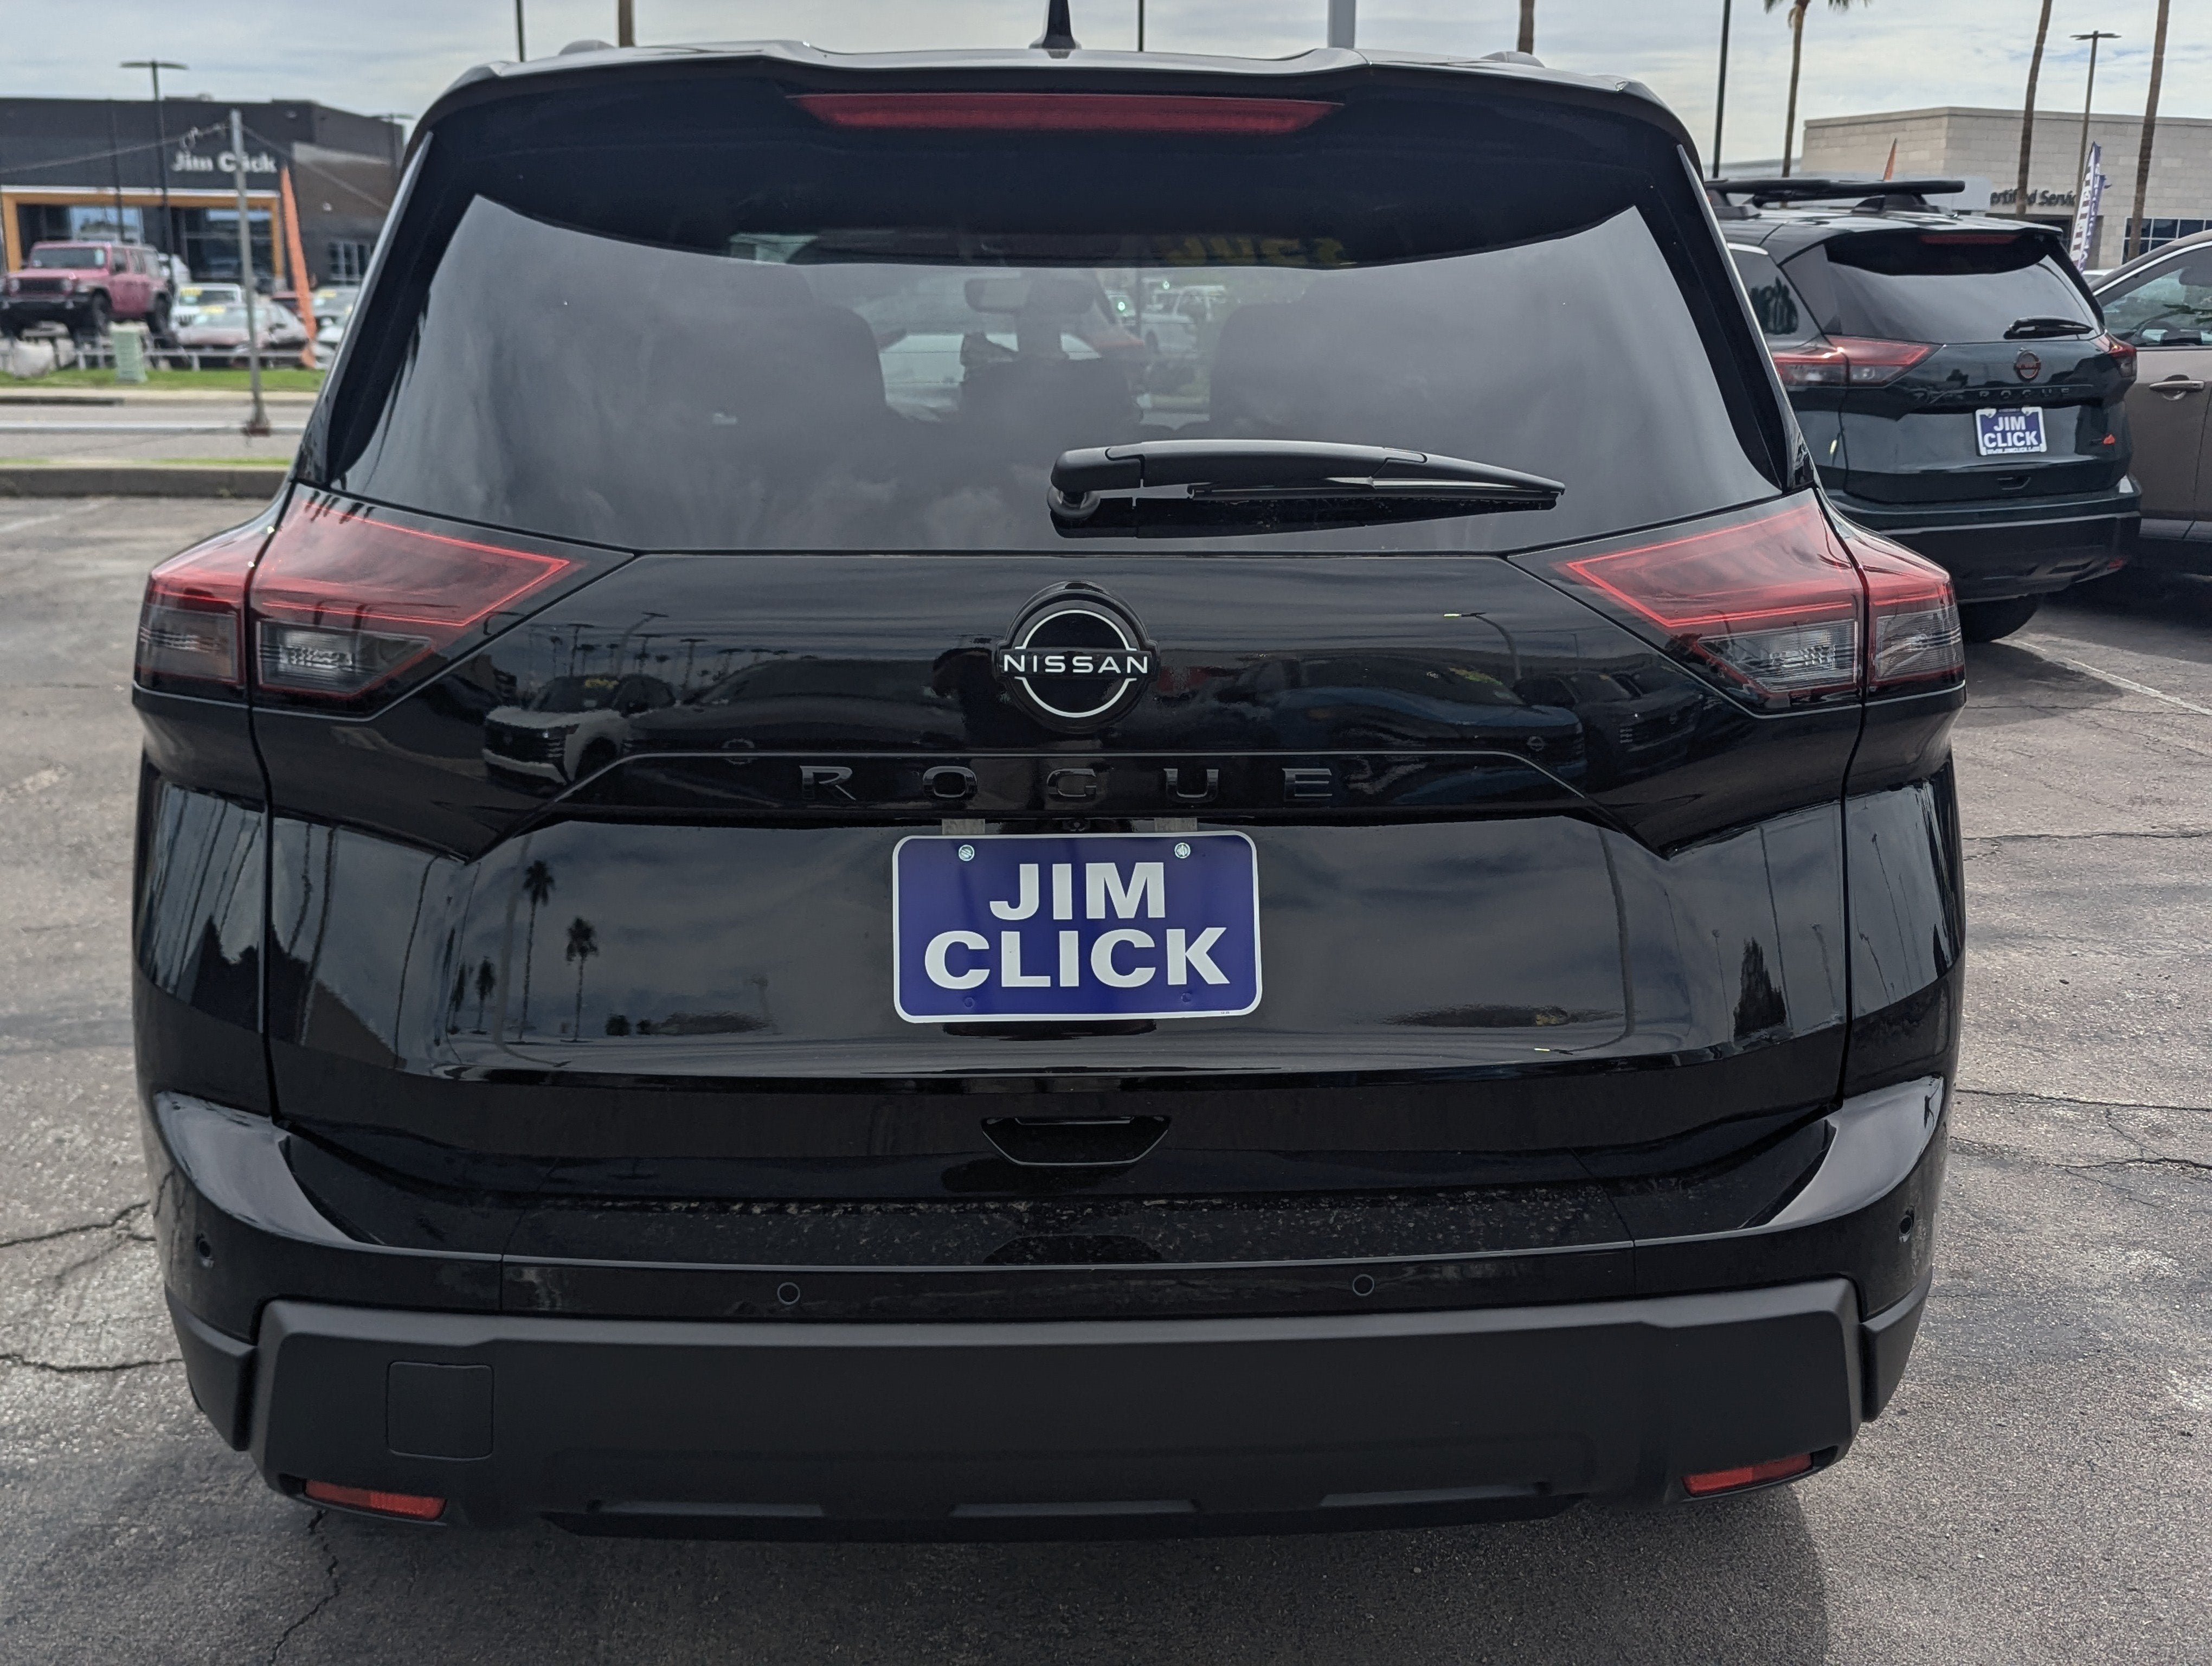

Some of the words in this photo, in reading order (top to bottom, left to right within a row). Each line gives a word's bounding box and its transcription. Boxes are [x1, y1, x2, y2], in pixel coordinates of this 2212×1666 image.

[172, 151, 214, 171] Jim
[218, 151, 278, 173] Cick
[2039, 190, 2076, 207] Servic
[1979, 387, 2069, 399] ROGUE
[1994, 416, 2026, 431] JIM
[1984, 431, 2039, 448] CLICK
[1004, 654, 1148, 674] NISSAN
[800, 765, 1334, 802] ROGUE
[989, 862, 1166, 920] JIM
[924, 927, 1231, 989] CLICK
